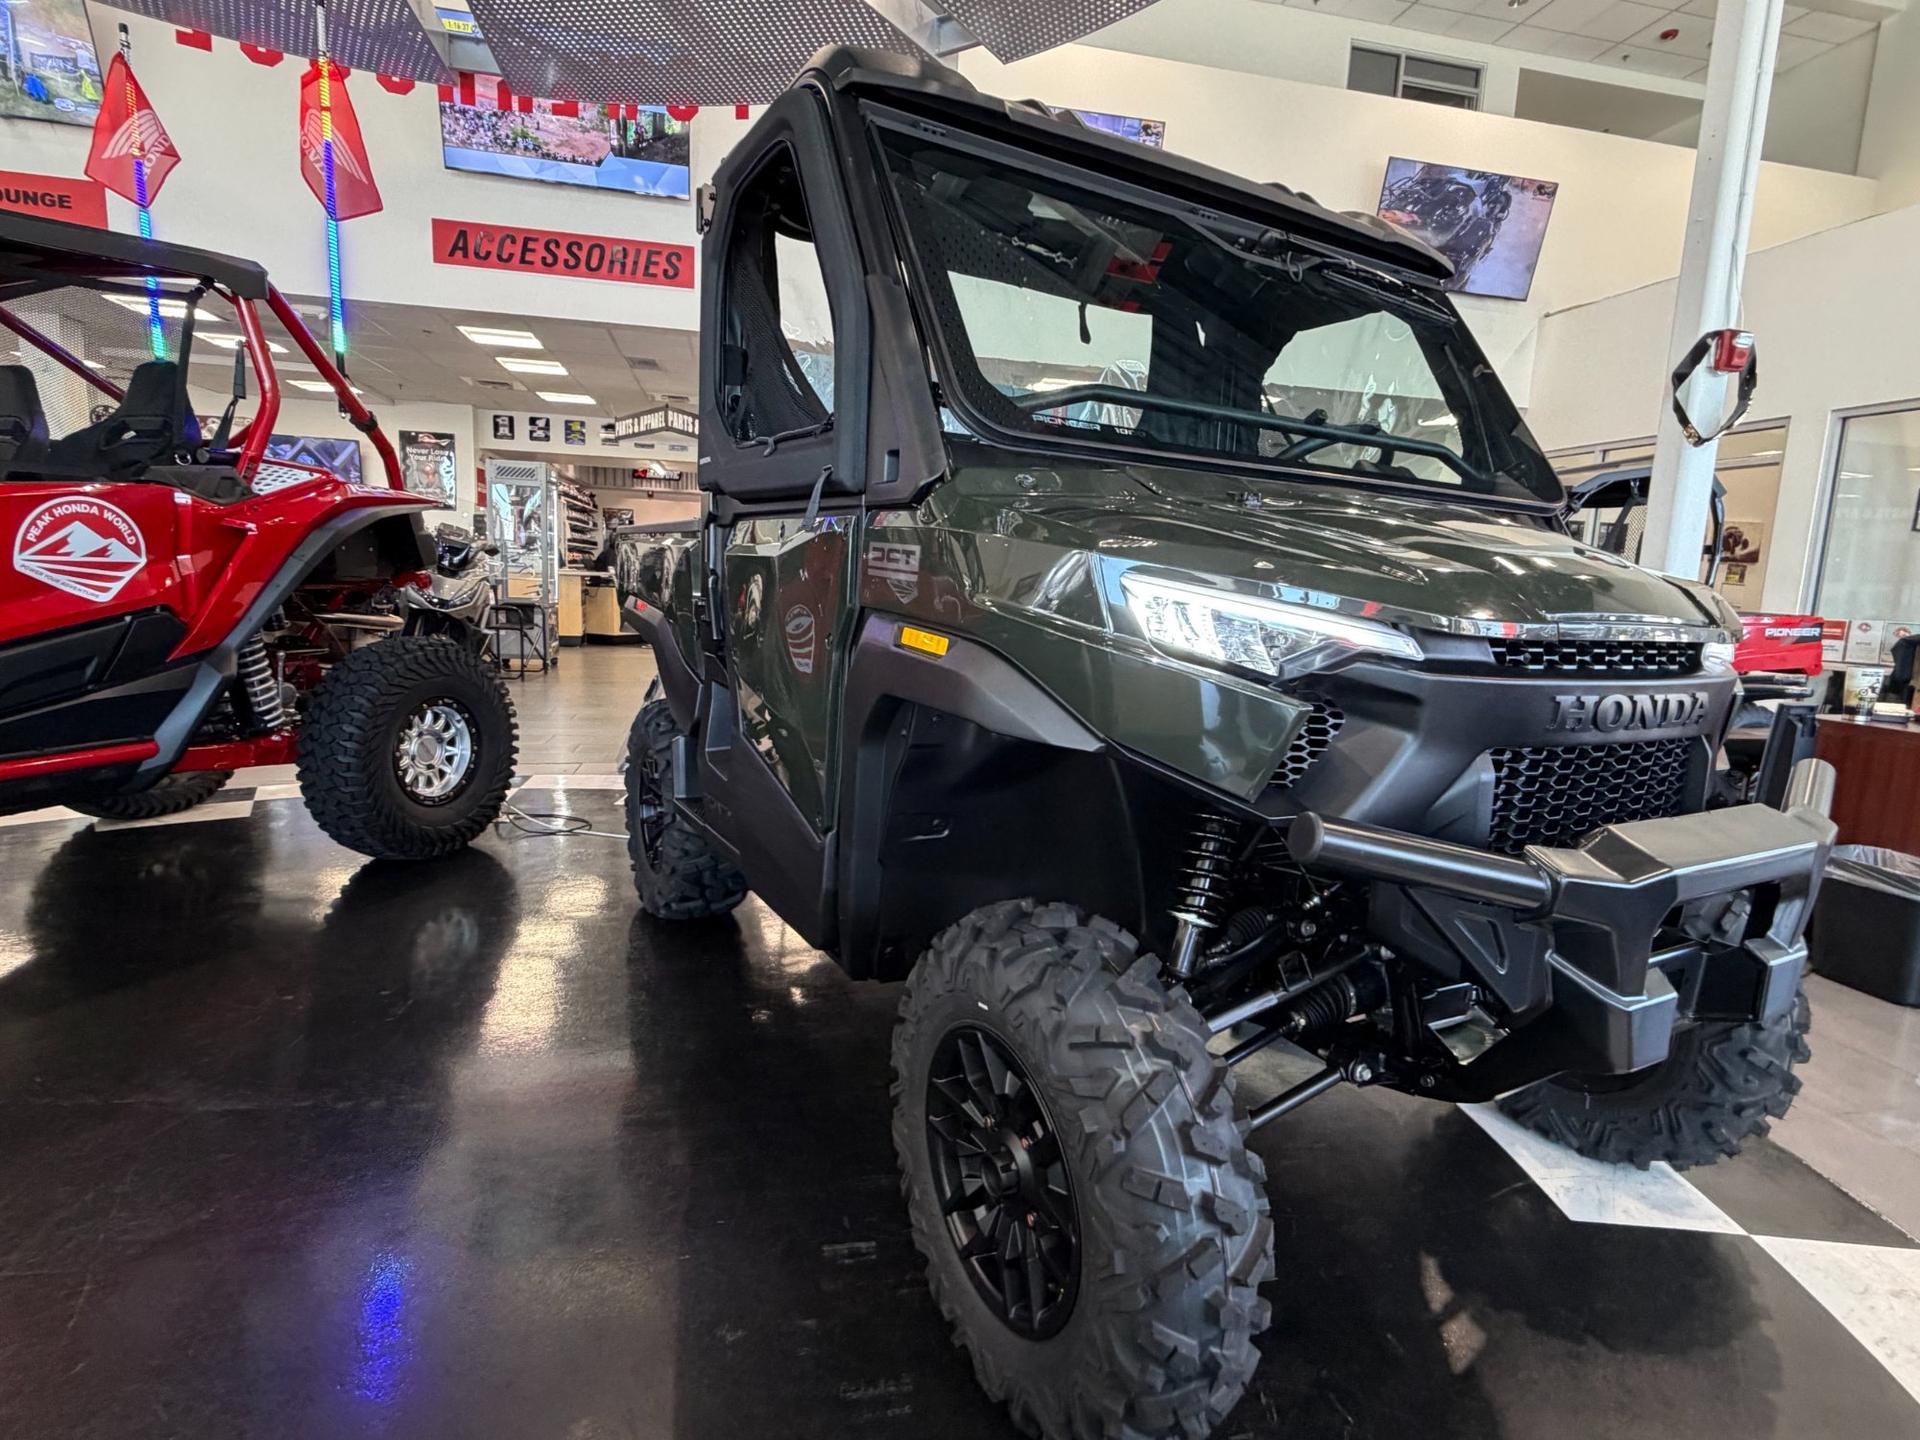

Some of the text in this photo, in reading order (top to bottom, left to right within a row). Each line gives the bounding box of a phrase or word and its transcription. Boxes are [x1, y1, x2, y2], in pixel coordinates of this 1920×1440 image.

[0, 188, 72, 209] UNGE
[448, 229, 682, 280] ACCESSORIES
[615, 411, 665, 437] PARTS & APPAREL
[668, 410, 693, 433] PARTS
[1032, 414, 1101, 431] PIONEER
[26, 503, 137, 546] PEAK HONDA WORLD
[1764, 627, 1820, 637] PIONEER
[1546, 691, 1710, 732] HONDA
